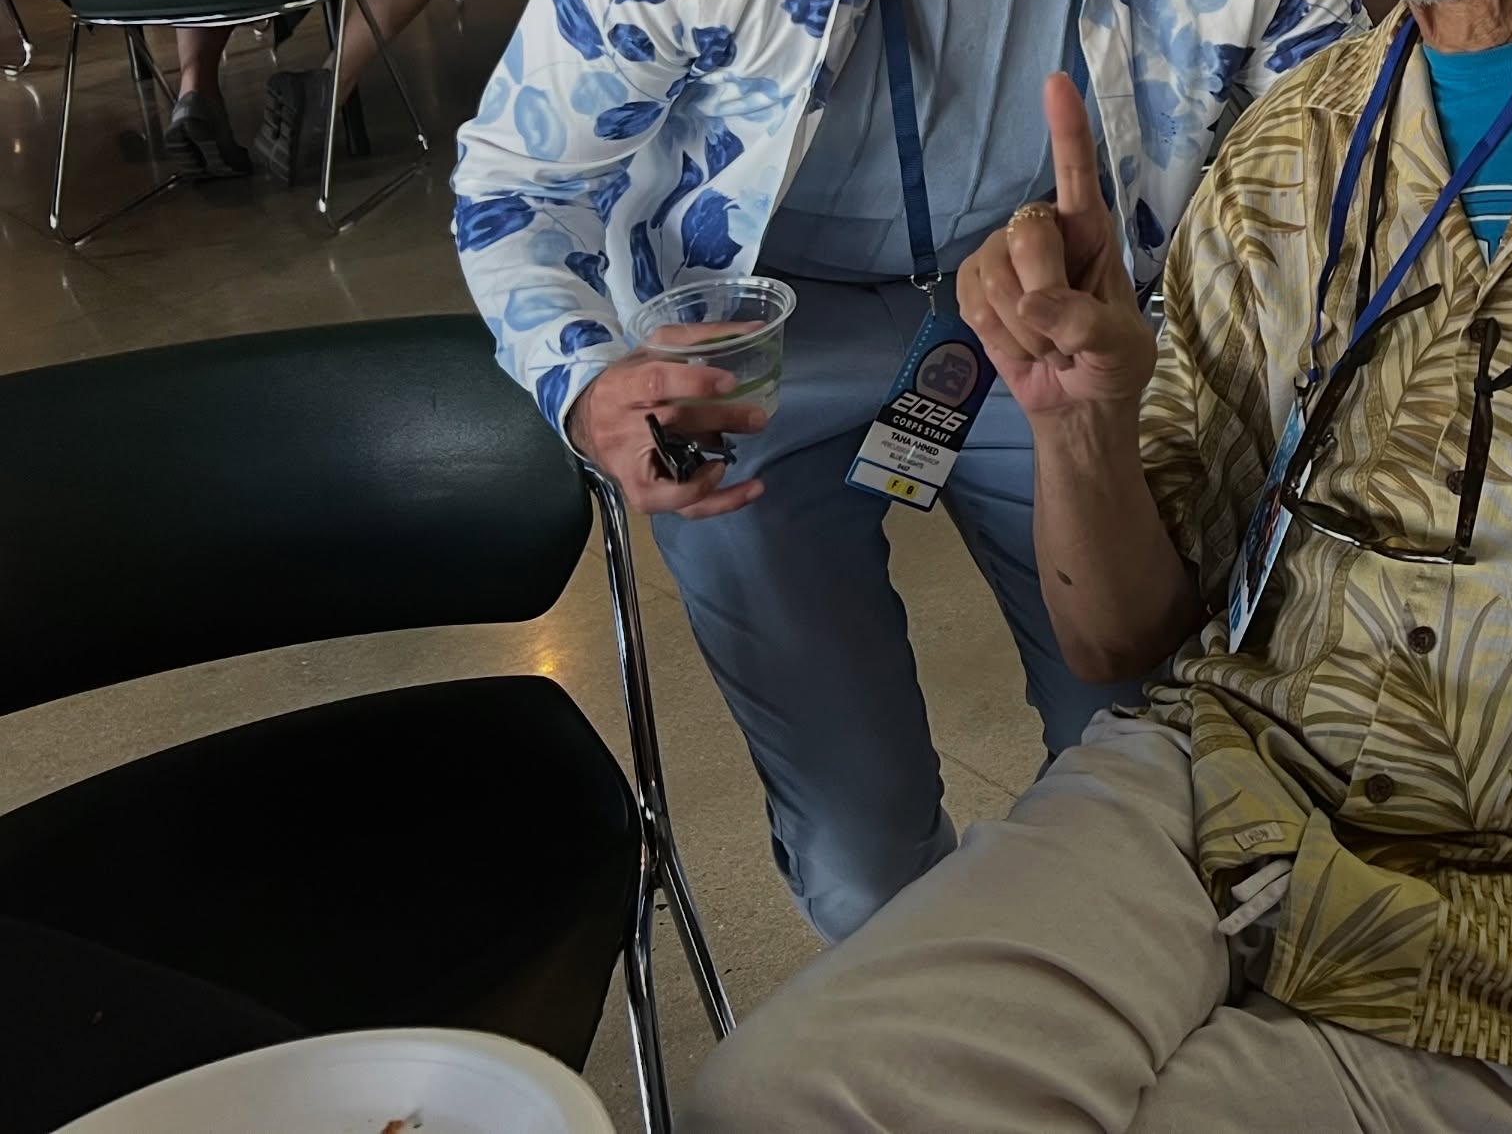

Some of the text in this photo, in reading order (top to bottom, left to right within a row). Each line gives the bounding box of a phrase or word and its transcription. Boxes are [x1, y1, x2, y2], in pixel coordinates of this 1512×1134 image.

[891, 391, 969, 432] 2026
[892, 415, 952, 443] CORPS STAFF
[891, 432, 940, 456] TAHA AHMED
[891, 480, 899, 489] F
